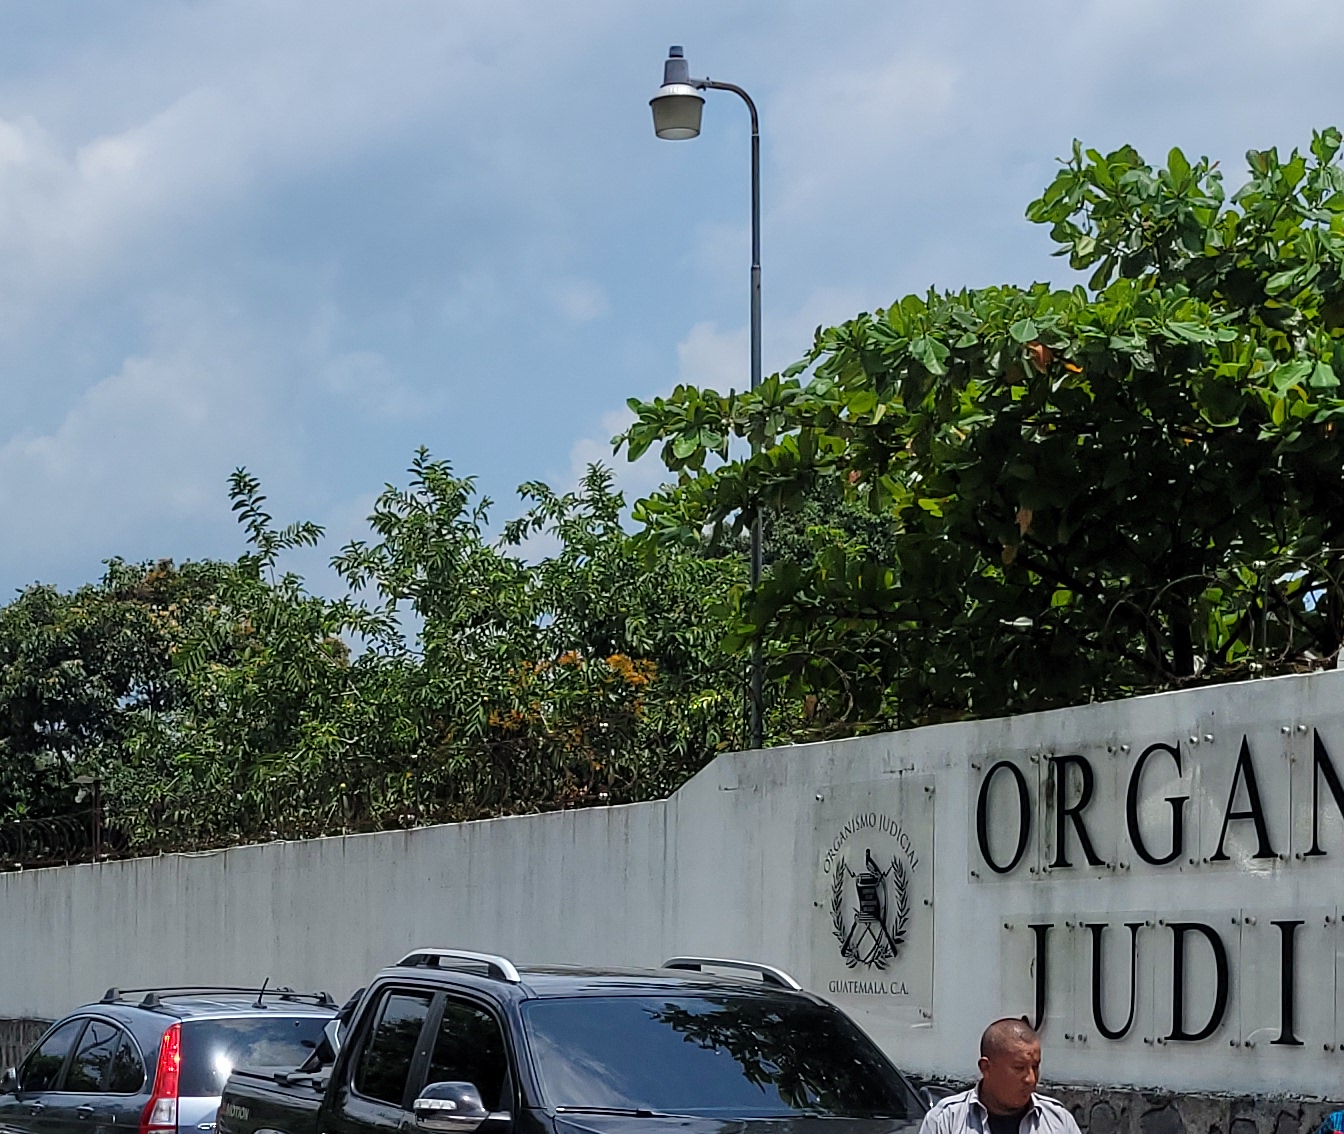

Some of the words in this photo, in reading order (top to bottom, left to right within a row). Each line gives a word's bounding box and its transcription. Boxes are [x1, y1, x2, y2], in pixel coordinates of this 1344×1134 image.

[823, 812, 877, 874] ORGANISMO
[878, 813, 920, 874] JUDICIAL
[890, 982, 909, 995] C.A.
